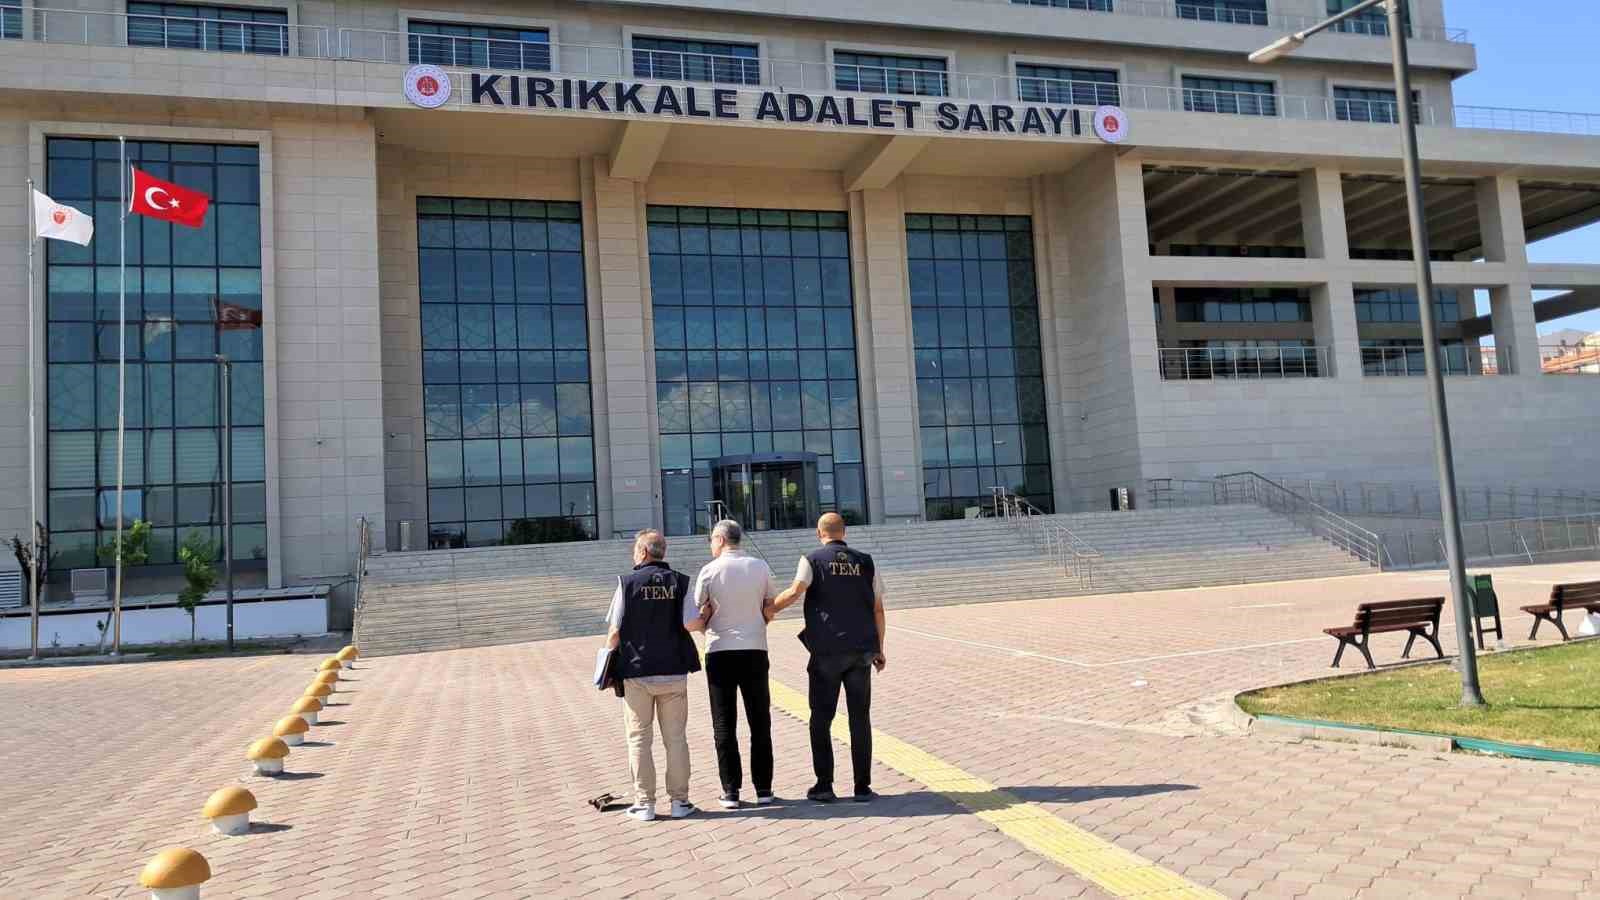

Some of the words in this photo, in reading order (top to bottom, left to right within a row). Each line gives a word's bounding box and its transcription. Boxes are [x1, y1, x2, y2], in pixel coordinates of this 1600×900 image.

[471, 73, 740, 119] KIRIKKALE
[756, 91, 921, 129] ADALET
[937, 102, 1081, 135] SARAYI
[829, 561, 861, 577] TEM
[641, 584, 677, 600] TEM
